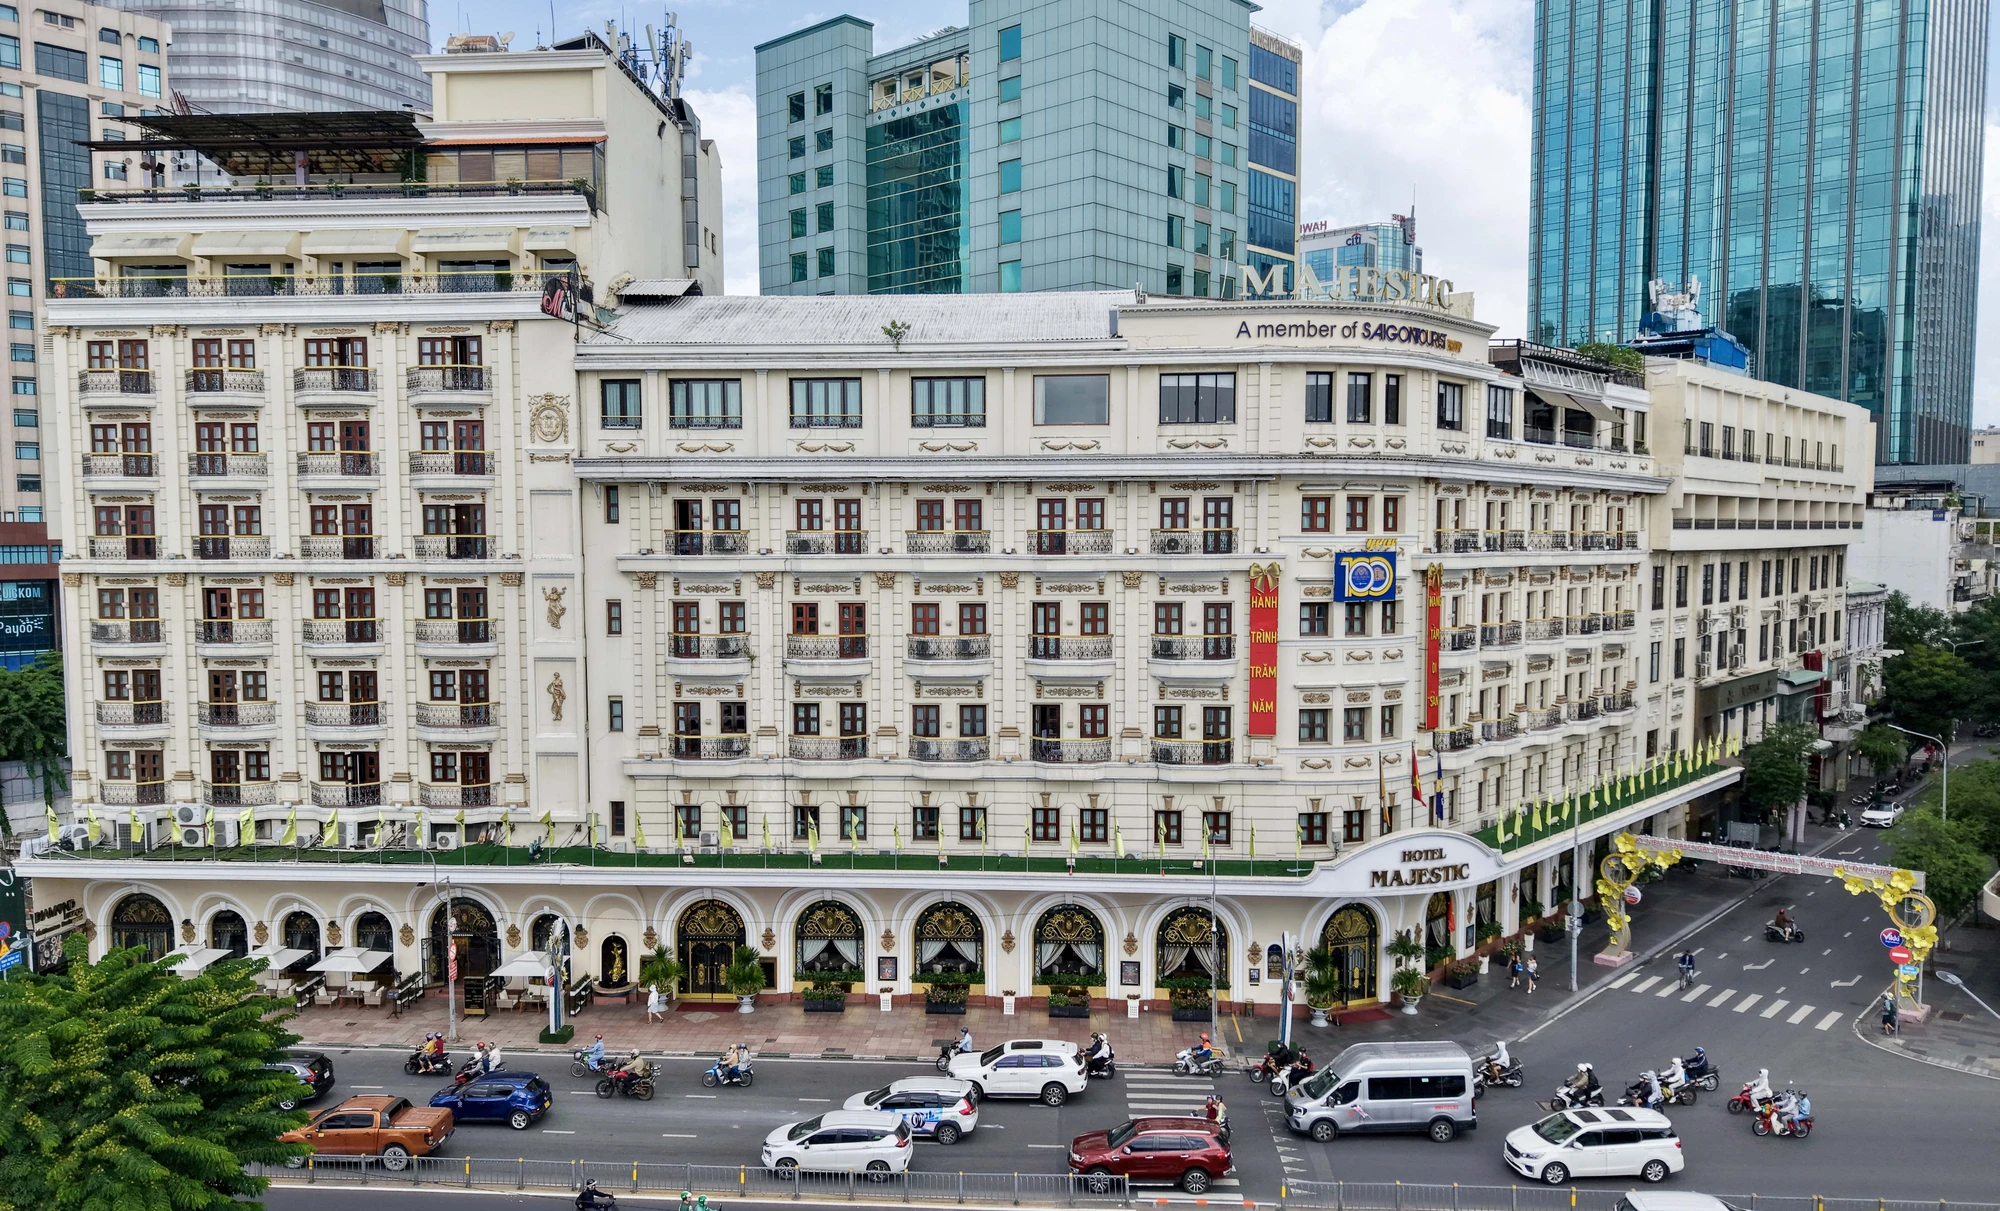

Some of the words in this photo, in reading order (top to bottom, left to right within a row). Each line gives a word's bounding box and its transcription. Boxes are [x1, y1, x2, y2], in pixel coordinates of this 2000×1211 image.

[1300, 221, 1327, 233] WAH
[1346, 233, 1361, 246] citi
[1238, 264, 1454, 310] MAJESTIC
[1236, 321, 1251, 338] A
[1257, 320, 1336, 338] member
[1342, 321, 1358, 338] of
[1361, 322, 1447, 350] SAIGONTOURIST
[1340, 556, 1393, 597] 100
[0, 587, 41, 599] UICKOM
[1251, 593, 1278, 608] HÀNH
[1251, 628, 1277, 643] TRÌNH
[1250, 663, 1277, 678] TRĂM
[1252, 698, 1274, 713] NĂM
[1401, 848, 1447, 862] HOTEL
[1370, 863, 1470, 887] MAJESTIC
